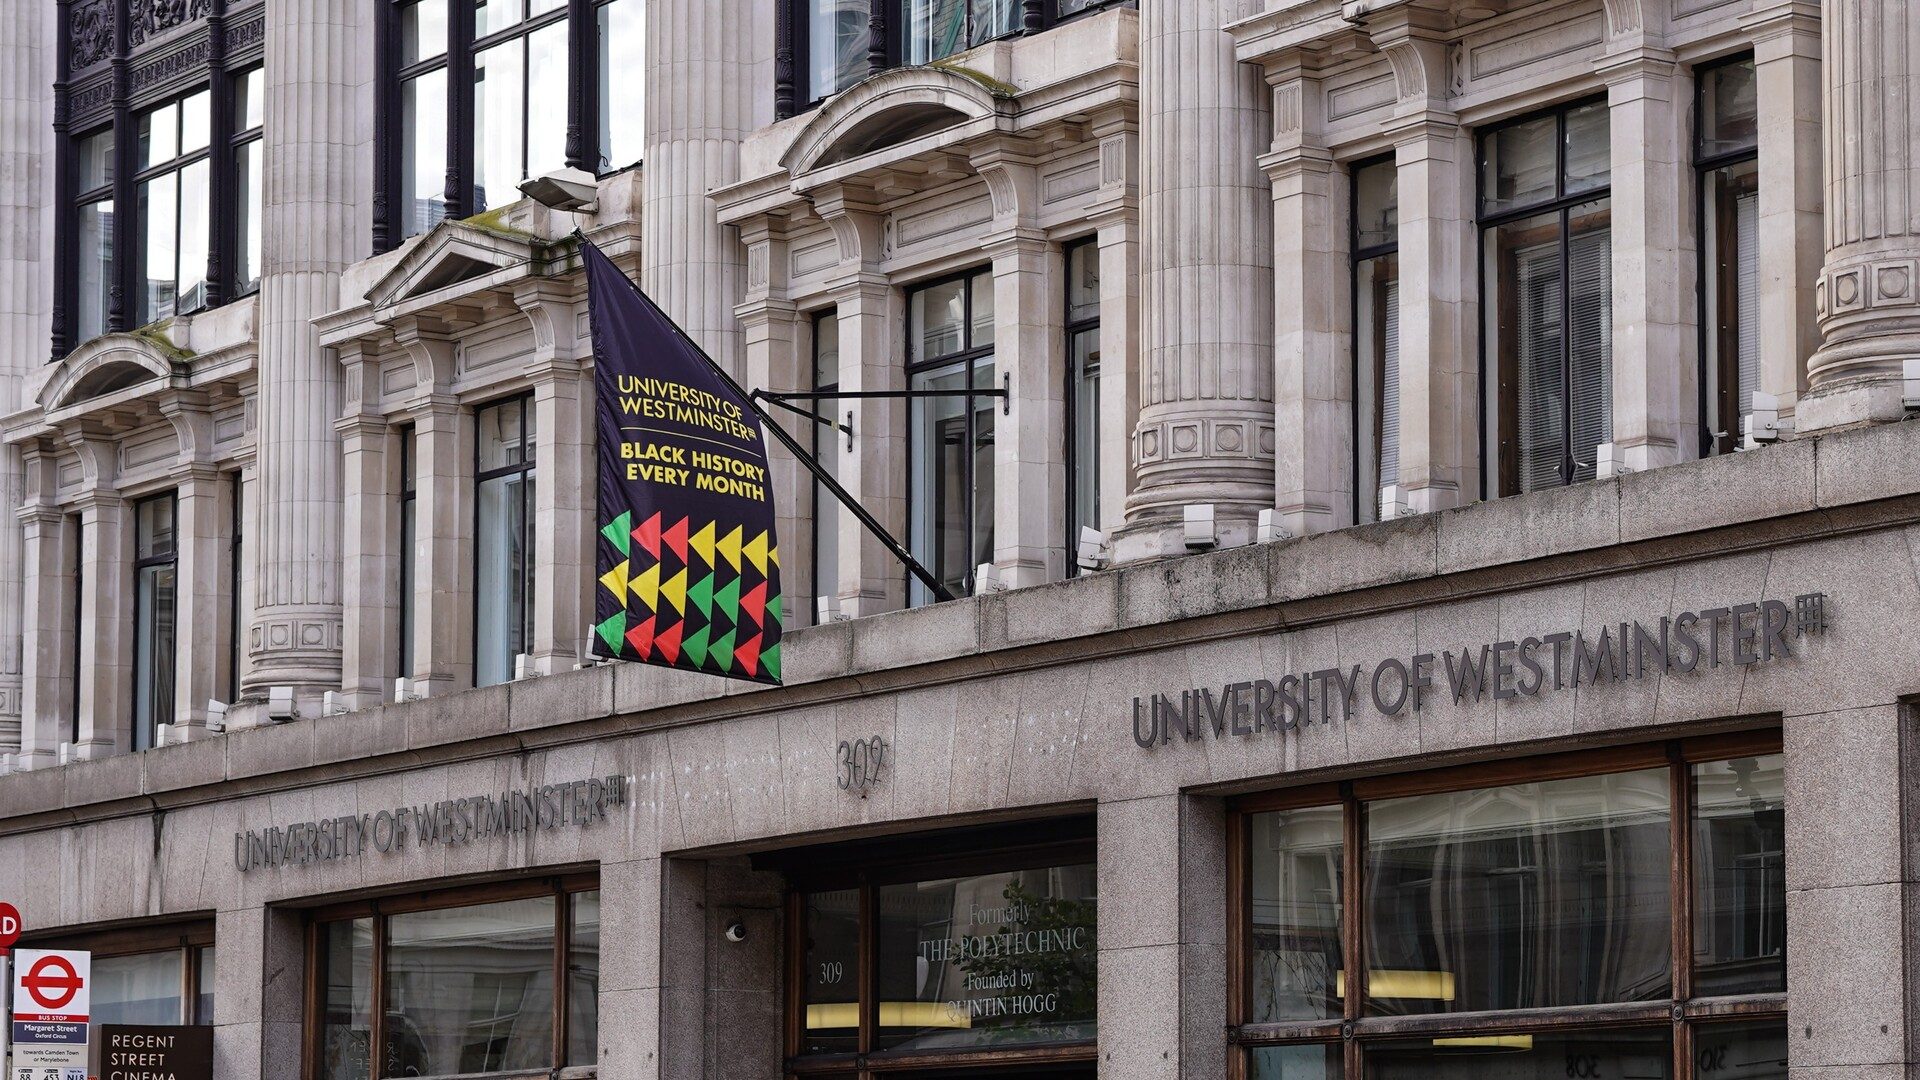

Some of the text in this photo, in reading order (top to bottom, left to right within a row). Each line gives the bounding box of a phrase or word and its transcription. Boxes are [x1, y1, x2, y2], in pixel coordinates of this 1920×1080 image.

[618, 375, 743, 421] UNIVERSITY OF
[619, 396, 750, 441] WESTMINSTER
[621, 442, 764, 482] BLACK HISTORY
[626, 463, 765, 502] EVERY MONTH
[1133, 600, 1792, 749] UNIVERSITY OF WESTMINSTER
[837, 735, 883, 790] 309
[234, 778, 605, 873] UNIVERSITY OF WESTMINSTER
[968, 899, 1030, 926] Formerly
[920, 927, 1086, 962] THE POLYTECHNIC
[819, 961, 843, 985] 309
[967, 969, 1034, 991] Founded by
[946, 993, 1057, 1023] QUINTIN HOGG
[24, 1024, 78, 1033] Margaret Street
[111, 1035, 175, 1048] REGENT
[111, 1053, 165, 1067] STREET
[111, 1071, 177, 1080] CINEMA
